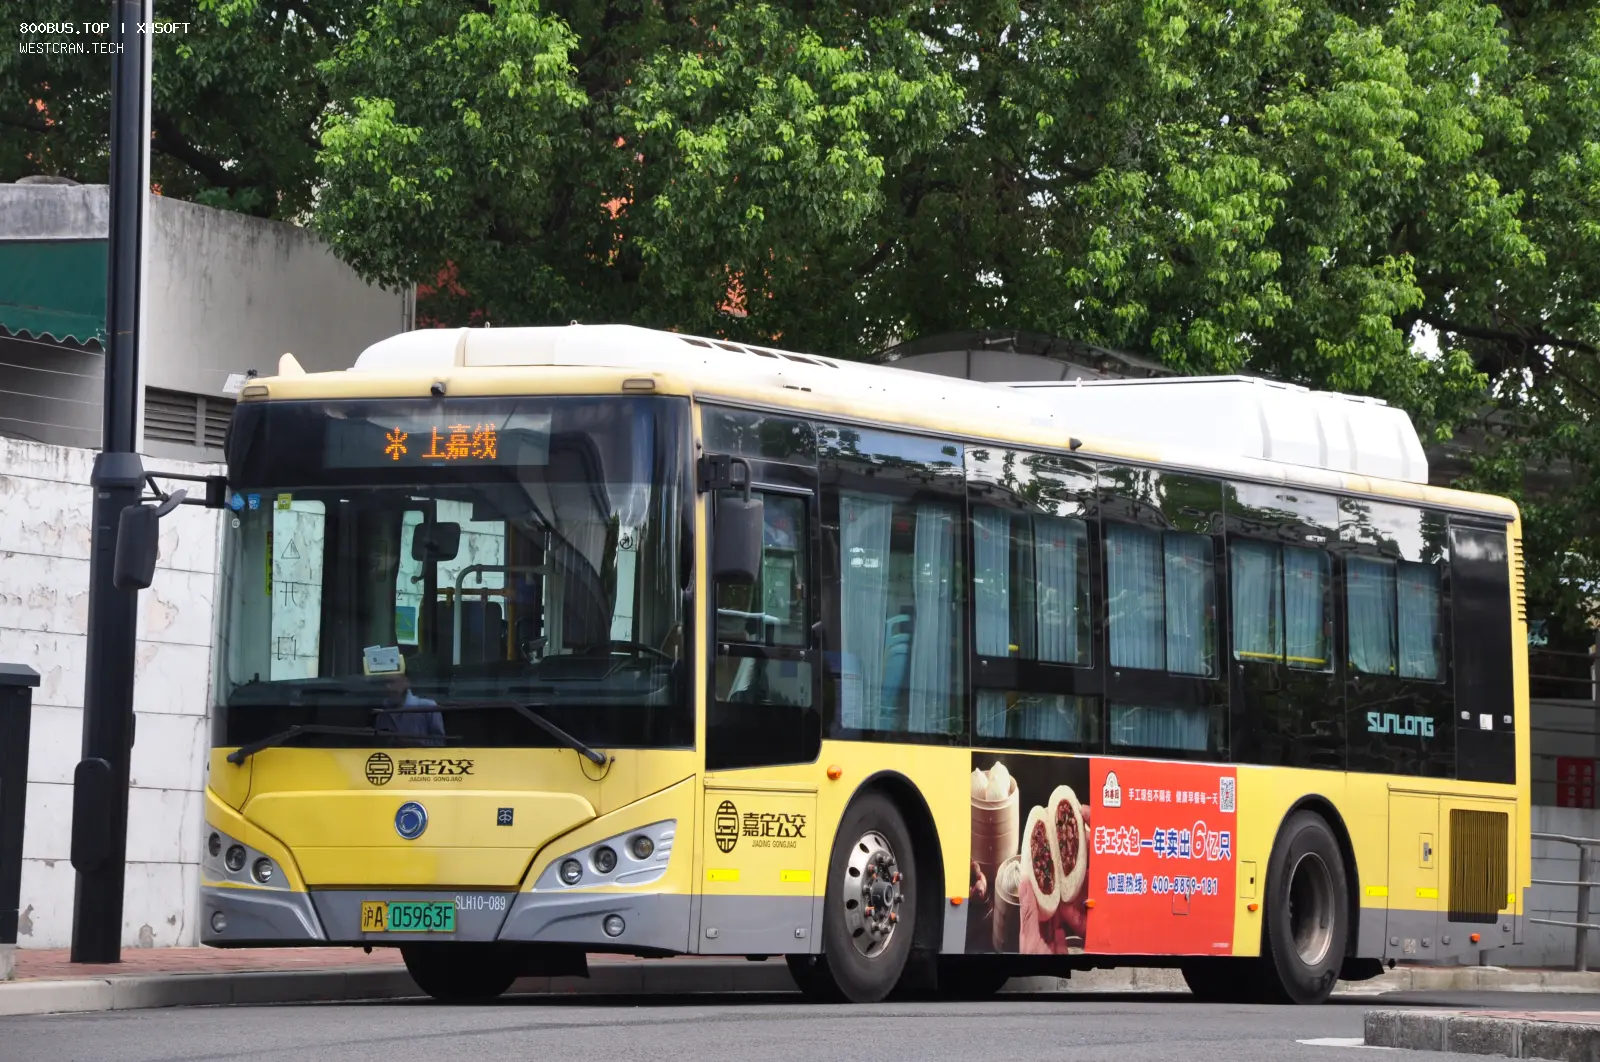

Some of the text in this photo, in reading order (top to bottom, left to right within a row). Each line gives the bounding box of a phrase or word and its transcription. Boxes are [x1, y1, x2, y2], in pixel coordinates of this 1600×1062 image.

[422, 424, 497, 459] 上嘉线
[1367, 711, 1434, 737] SUNLONG
[397, 759, 475, 776] 嘉定公交
[742, 812, 806, 838] 嘉定公交
[1151, 875, 1218, 896] 400-8899-181
[455, 895, 506, 911] SLH10-089
